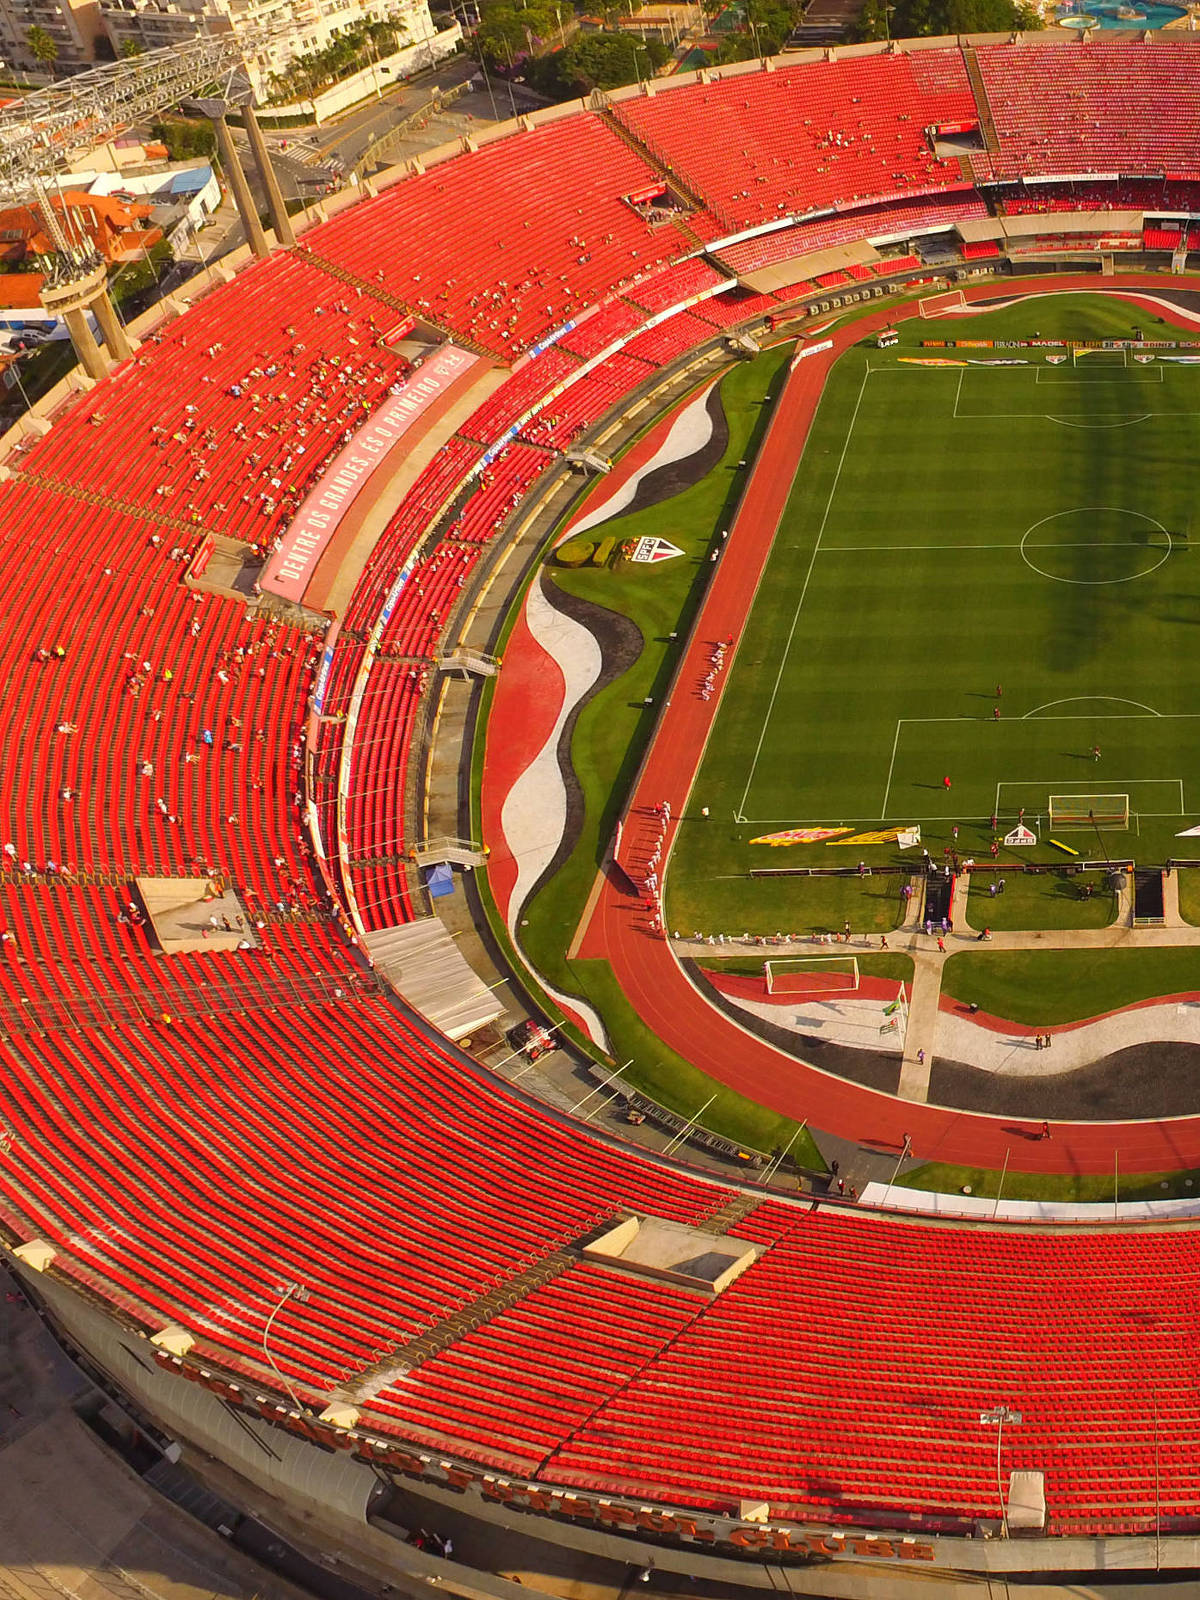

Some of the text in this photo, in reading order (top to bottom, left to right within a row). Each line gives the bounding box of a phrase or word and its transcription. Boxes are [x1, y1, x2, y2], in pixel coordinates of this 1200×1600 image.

[279, 529, 320, 580] DENTRE
[309, 511, 331, 529] OS
[320, 456, 376, 510] GRANDES,
[362, 432, 385, 454] ÉS
[376, 426, 392, 437] O
[385, 377, 441, 427] PRIMEIRO
[637, 538, 656, 561] SPFC
[730, 1527, 935, 1561] CLUBE
